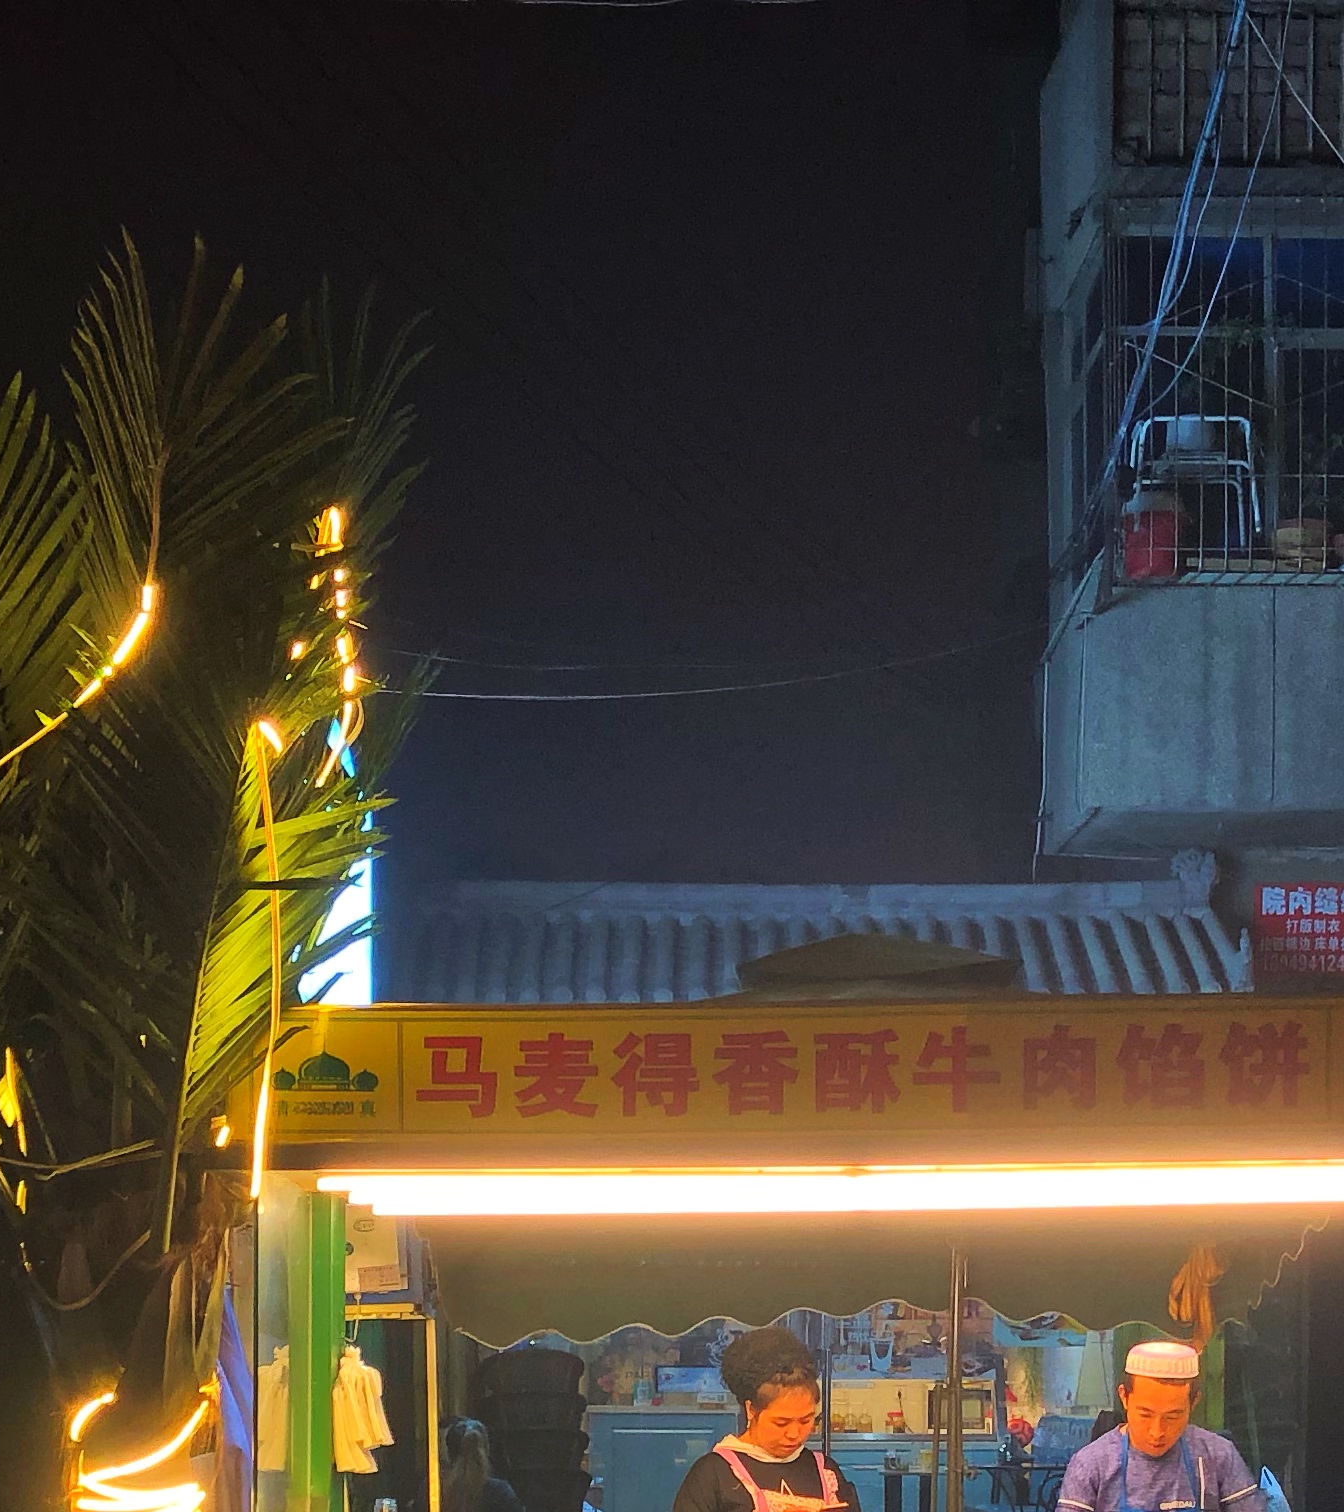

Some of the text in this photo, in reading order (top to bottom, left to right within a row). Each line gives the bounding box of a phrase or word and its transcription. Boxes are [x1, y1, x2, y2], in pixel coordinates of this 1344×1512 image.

[415, 1020, 1312, 1119] 马麦得香酥牛肉馅饼
